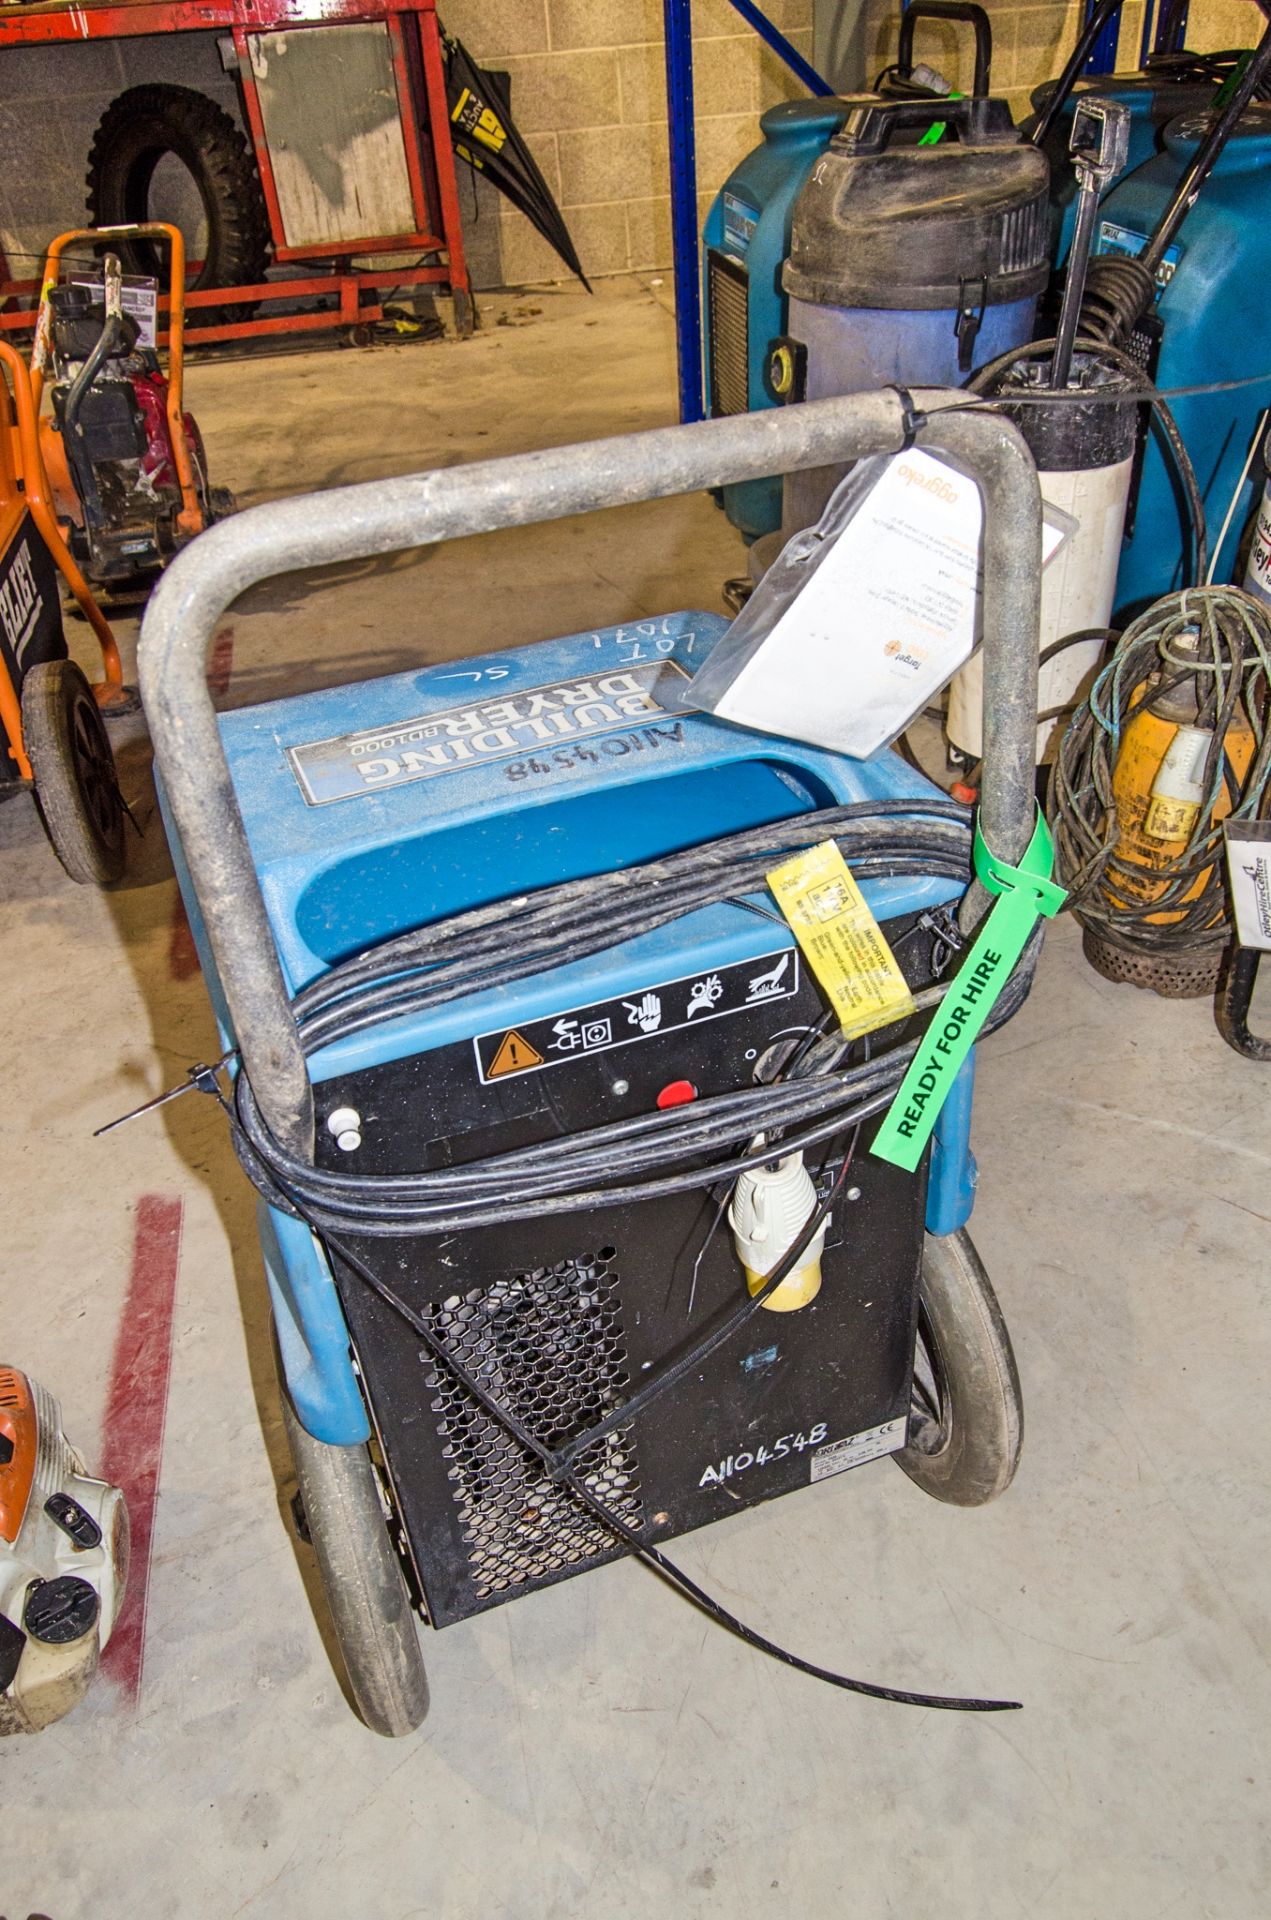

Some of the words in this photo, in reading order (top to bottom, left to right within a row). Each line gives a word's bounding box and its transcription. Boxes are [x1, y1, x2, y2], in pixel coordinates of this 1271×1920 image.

[465, 100, 483, 132] AUCTI
[898, 464, 957, 504] aggreko
[592, 619, 669, 648] 1071
[619, 633, 696, 662] LOT
[895, 654, 921, 671] Target
[436, 672, 644, 736] DRYER
[350, 725, 440, 757] BD1000
[358, 691, 664, 784] BUILDING
[833, 882, 851, 905] 16A
[863, 928, 893, 977] IMPORTANT
[897, 1056, 943, 1138] READY
[936, 1006, 970, 1055] FOR
[962, 949, 1002, 1004] HIRE
[699, 1423, 828, 1487] A1104548
